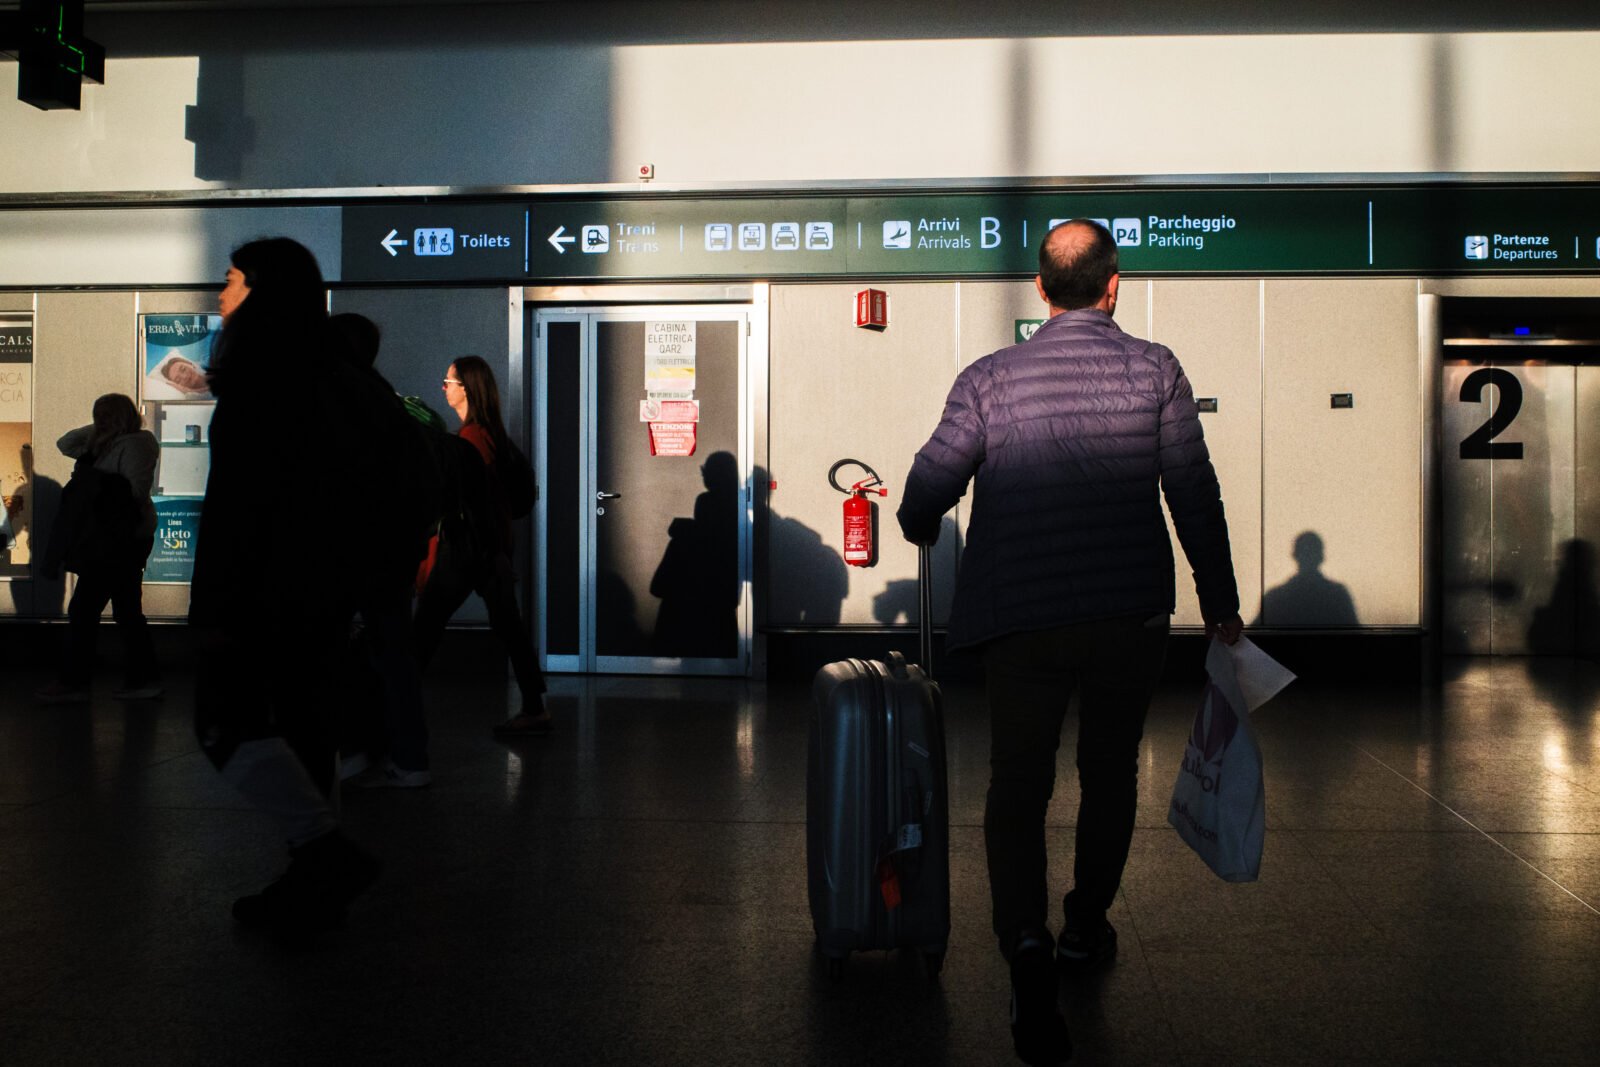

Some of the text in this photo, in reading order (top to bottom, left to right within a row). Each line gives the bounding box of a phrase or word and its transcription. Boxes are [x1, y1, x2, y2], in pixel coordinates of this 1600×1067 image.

[616, 222, 656, 236] Treni
[917, 217, 960, 232] Arrivi
[1148, 215, 1237, 232] Parcheggio
[980, 216, 1002, 250] B
[1116, 228, 1138, 244] P4
[1493, 234, 1550, 246] Partenze
[460, 233, 511, 249] Toilets
[917, 234, 971, 250] Arrivals
[1148, 232, 1204, 250] Parking
[1493, 248, 1559, 261] Departures
[148, 324, 207, 334] ERBA VITA
[654, 323, 687, 333] CABINA
[648, 334, 693, 344] ELETTRICA
[659, 344, 682, 354] QAR2
[1459, 367, 1524, 460] 2
[159, 527, 191, 539] Lieto
